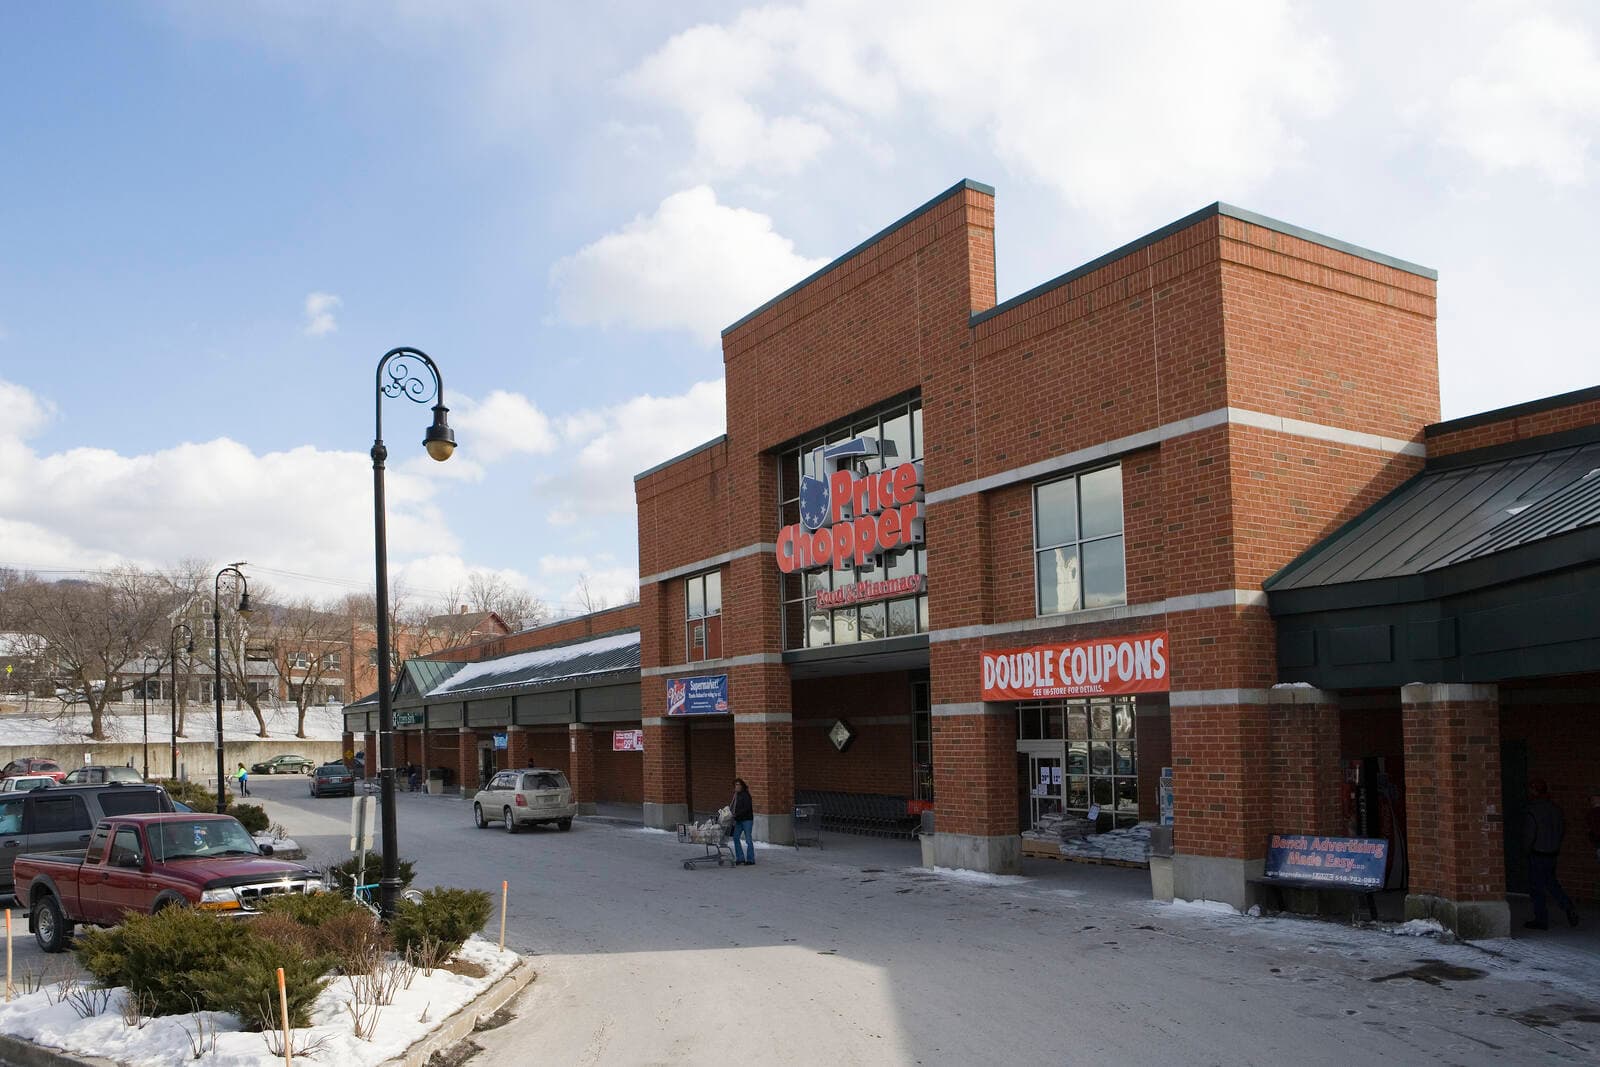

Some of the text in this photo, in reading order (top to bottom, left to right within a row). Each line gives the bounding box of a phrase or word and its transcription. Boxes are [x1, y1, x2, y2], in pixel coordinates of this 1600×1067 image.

[831, 463, 917, 521] Price
[776, 503, 917, 573] Chopper
[816, 574, 920, 607] Food & Pharmacy
[983, 638, 1166, 689] DOUBLE COUPONS
[1043, 687, 1066, 696] IN-STORE
[1080, 685, 1104, 694] DETAILS.
[1272, 835, 1384, 858] Bench Advertising
[1287, 852, 1322, 866] Made
